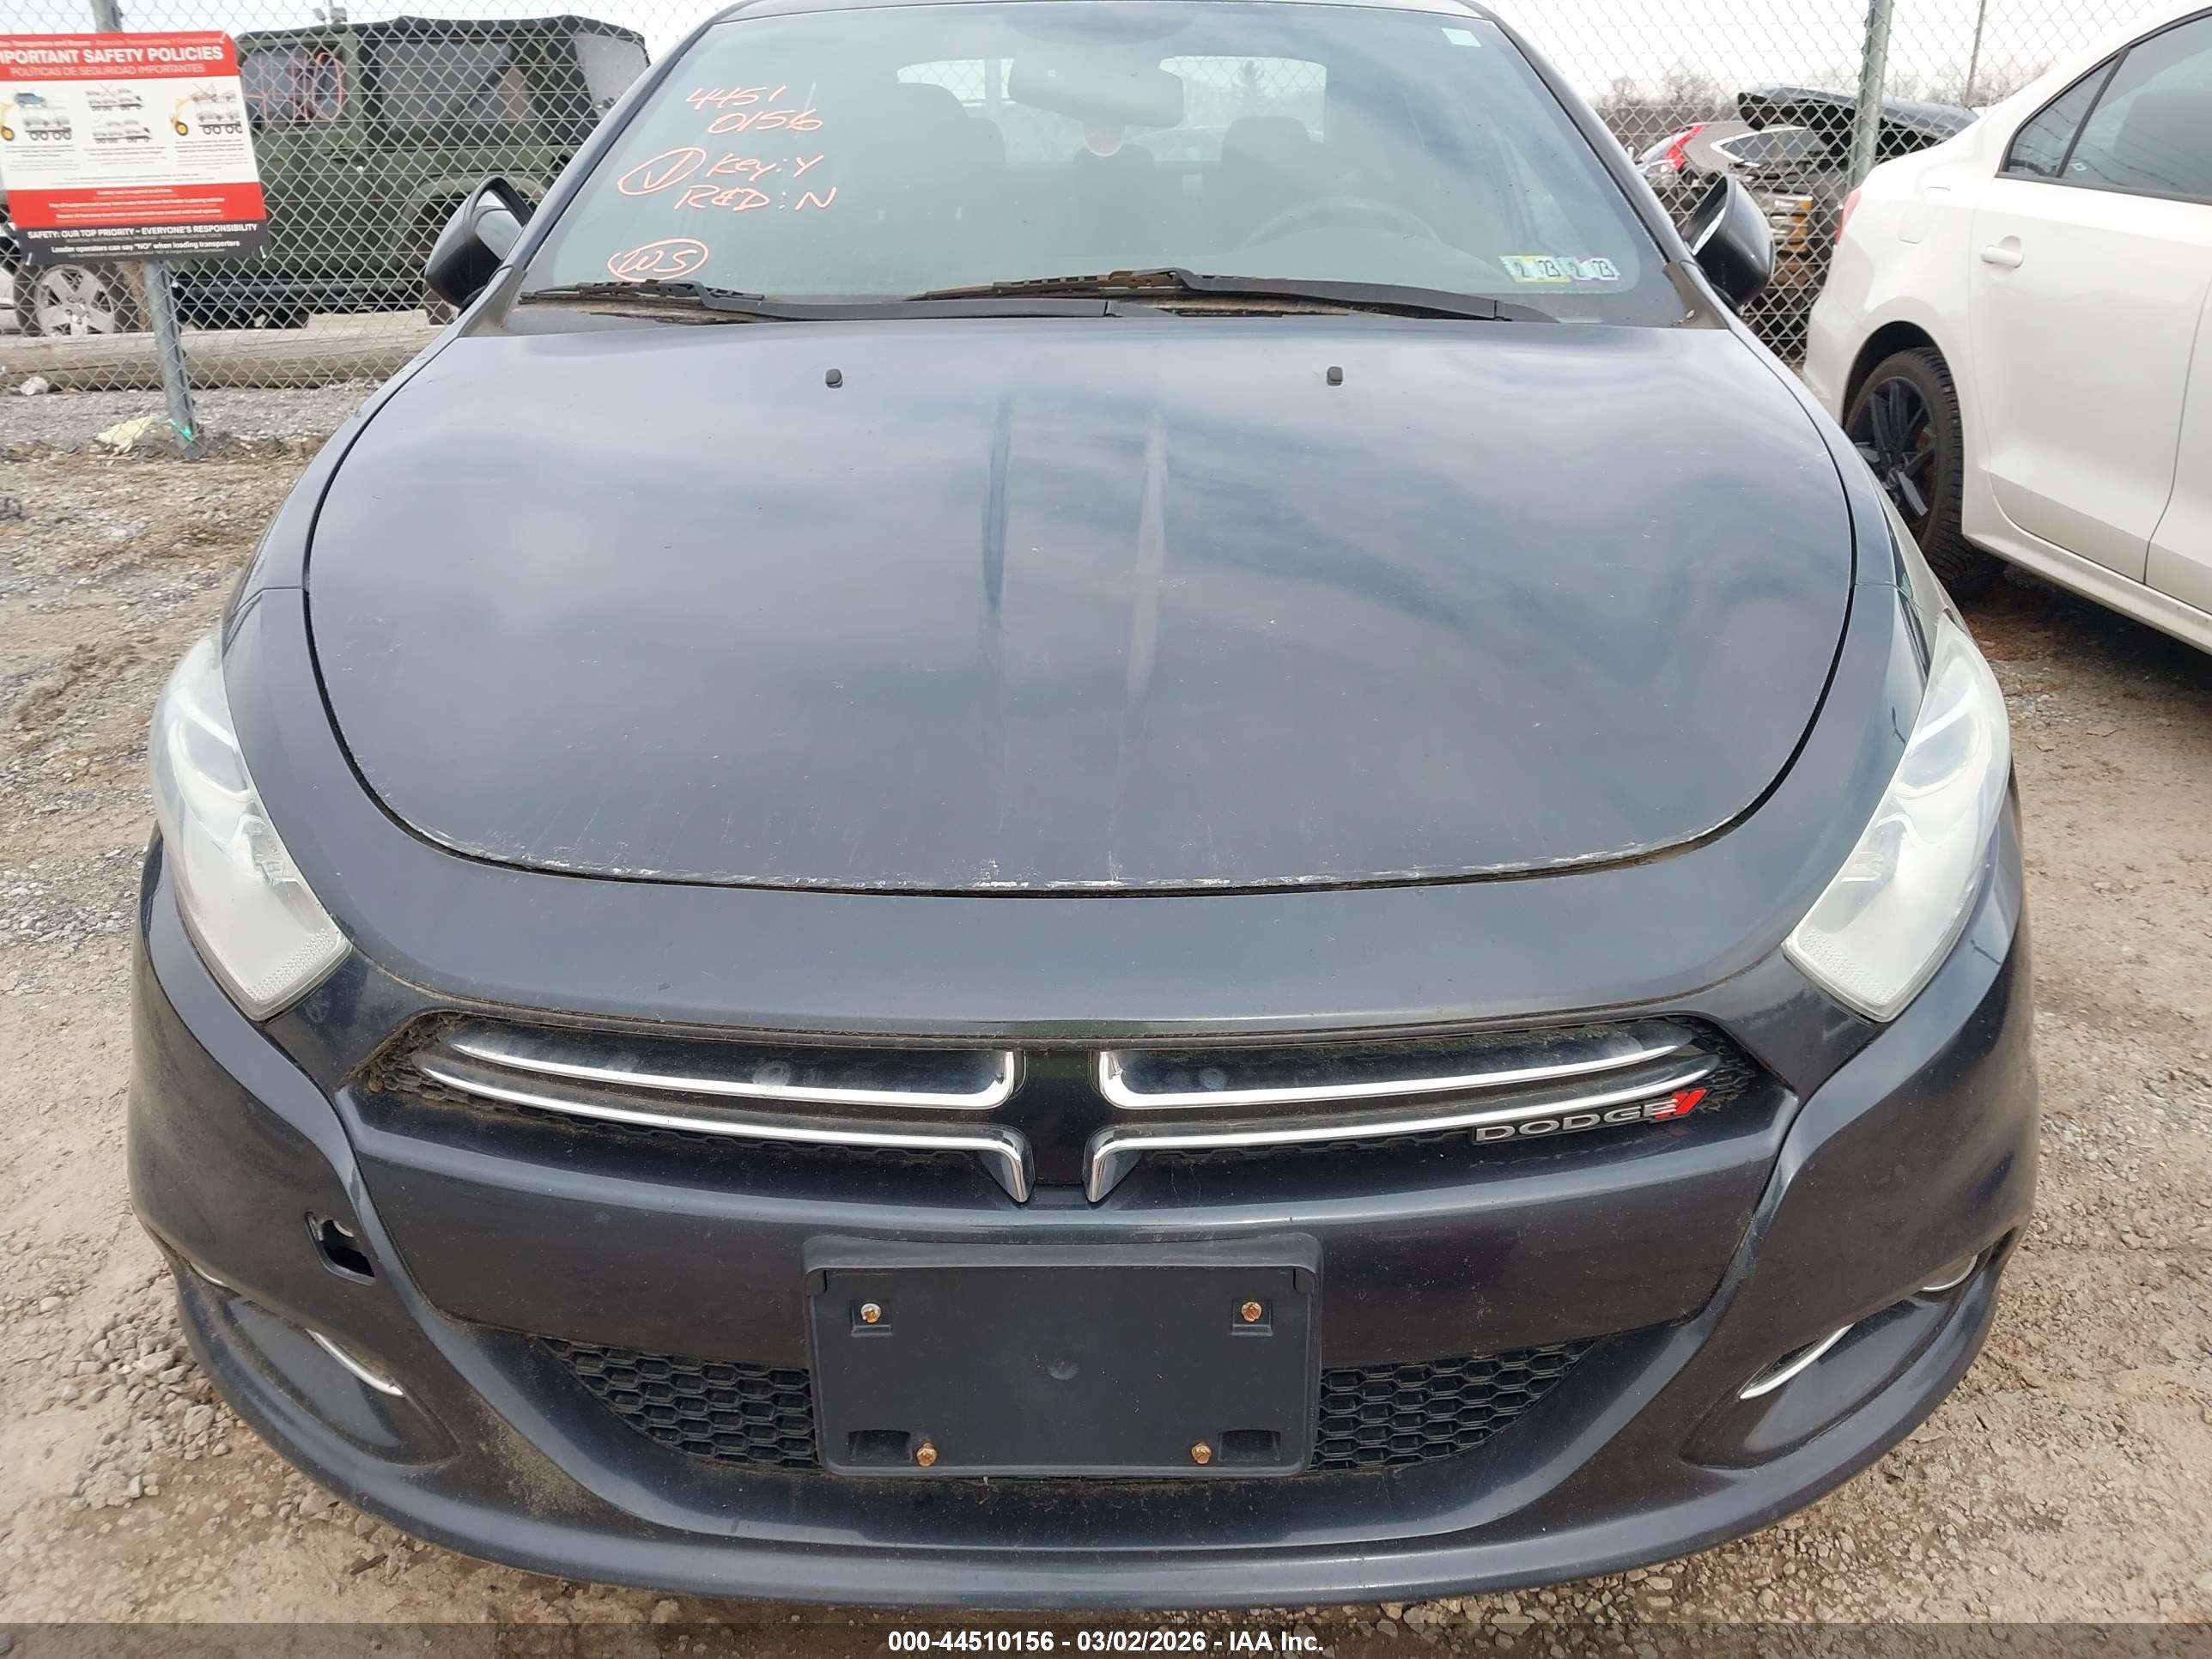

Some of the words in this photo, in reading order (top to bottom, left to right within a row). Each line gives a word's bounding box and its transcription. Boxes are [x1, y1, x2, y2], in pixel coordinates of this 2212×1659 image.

[0, 49, 79, 64] PORTANT
[83, 47, 143, 64] SAFETY
[148, 46, 224, 62] POLICIES
[685, 85, 787, 110] 4451
[707, 108, 824, 134] 0156
[61, 229, 80, 238] OUR
[98, 228, 135, 236] PRIORITY
[193, 223, 258, 234] RESPONSIBILITY
[1475, 1098, 1679, 1142] DODGE
